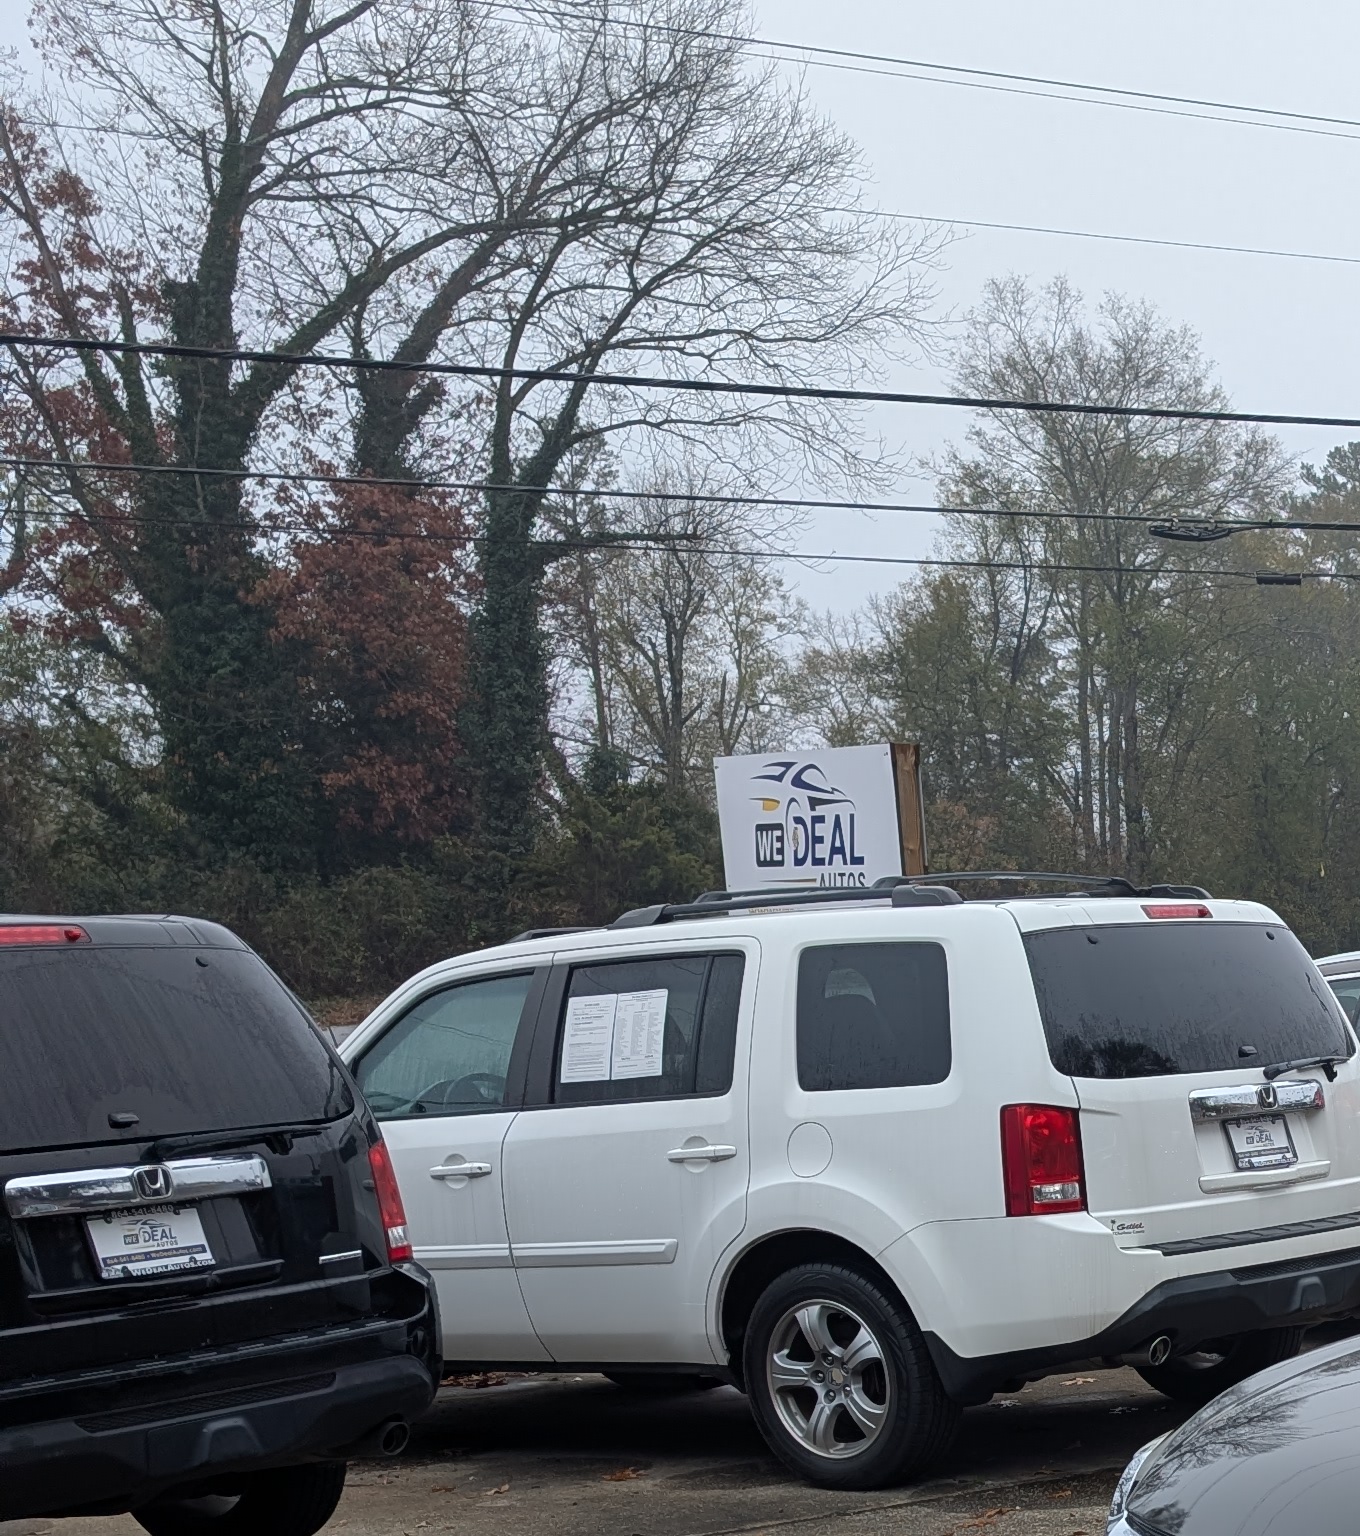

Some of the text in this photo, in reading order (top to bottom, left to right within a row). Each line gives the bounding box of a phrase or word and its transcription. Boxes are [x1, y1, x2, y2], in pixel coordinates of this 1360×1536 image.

[756, 813, 865, 867] WE DEAL
[819, 872, 866, 887] AUTOS
[1255, 1133, 1274, 1143] DEAL
[124, 1227, 177, 1244] WE DEAL
